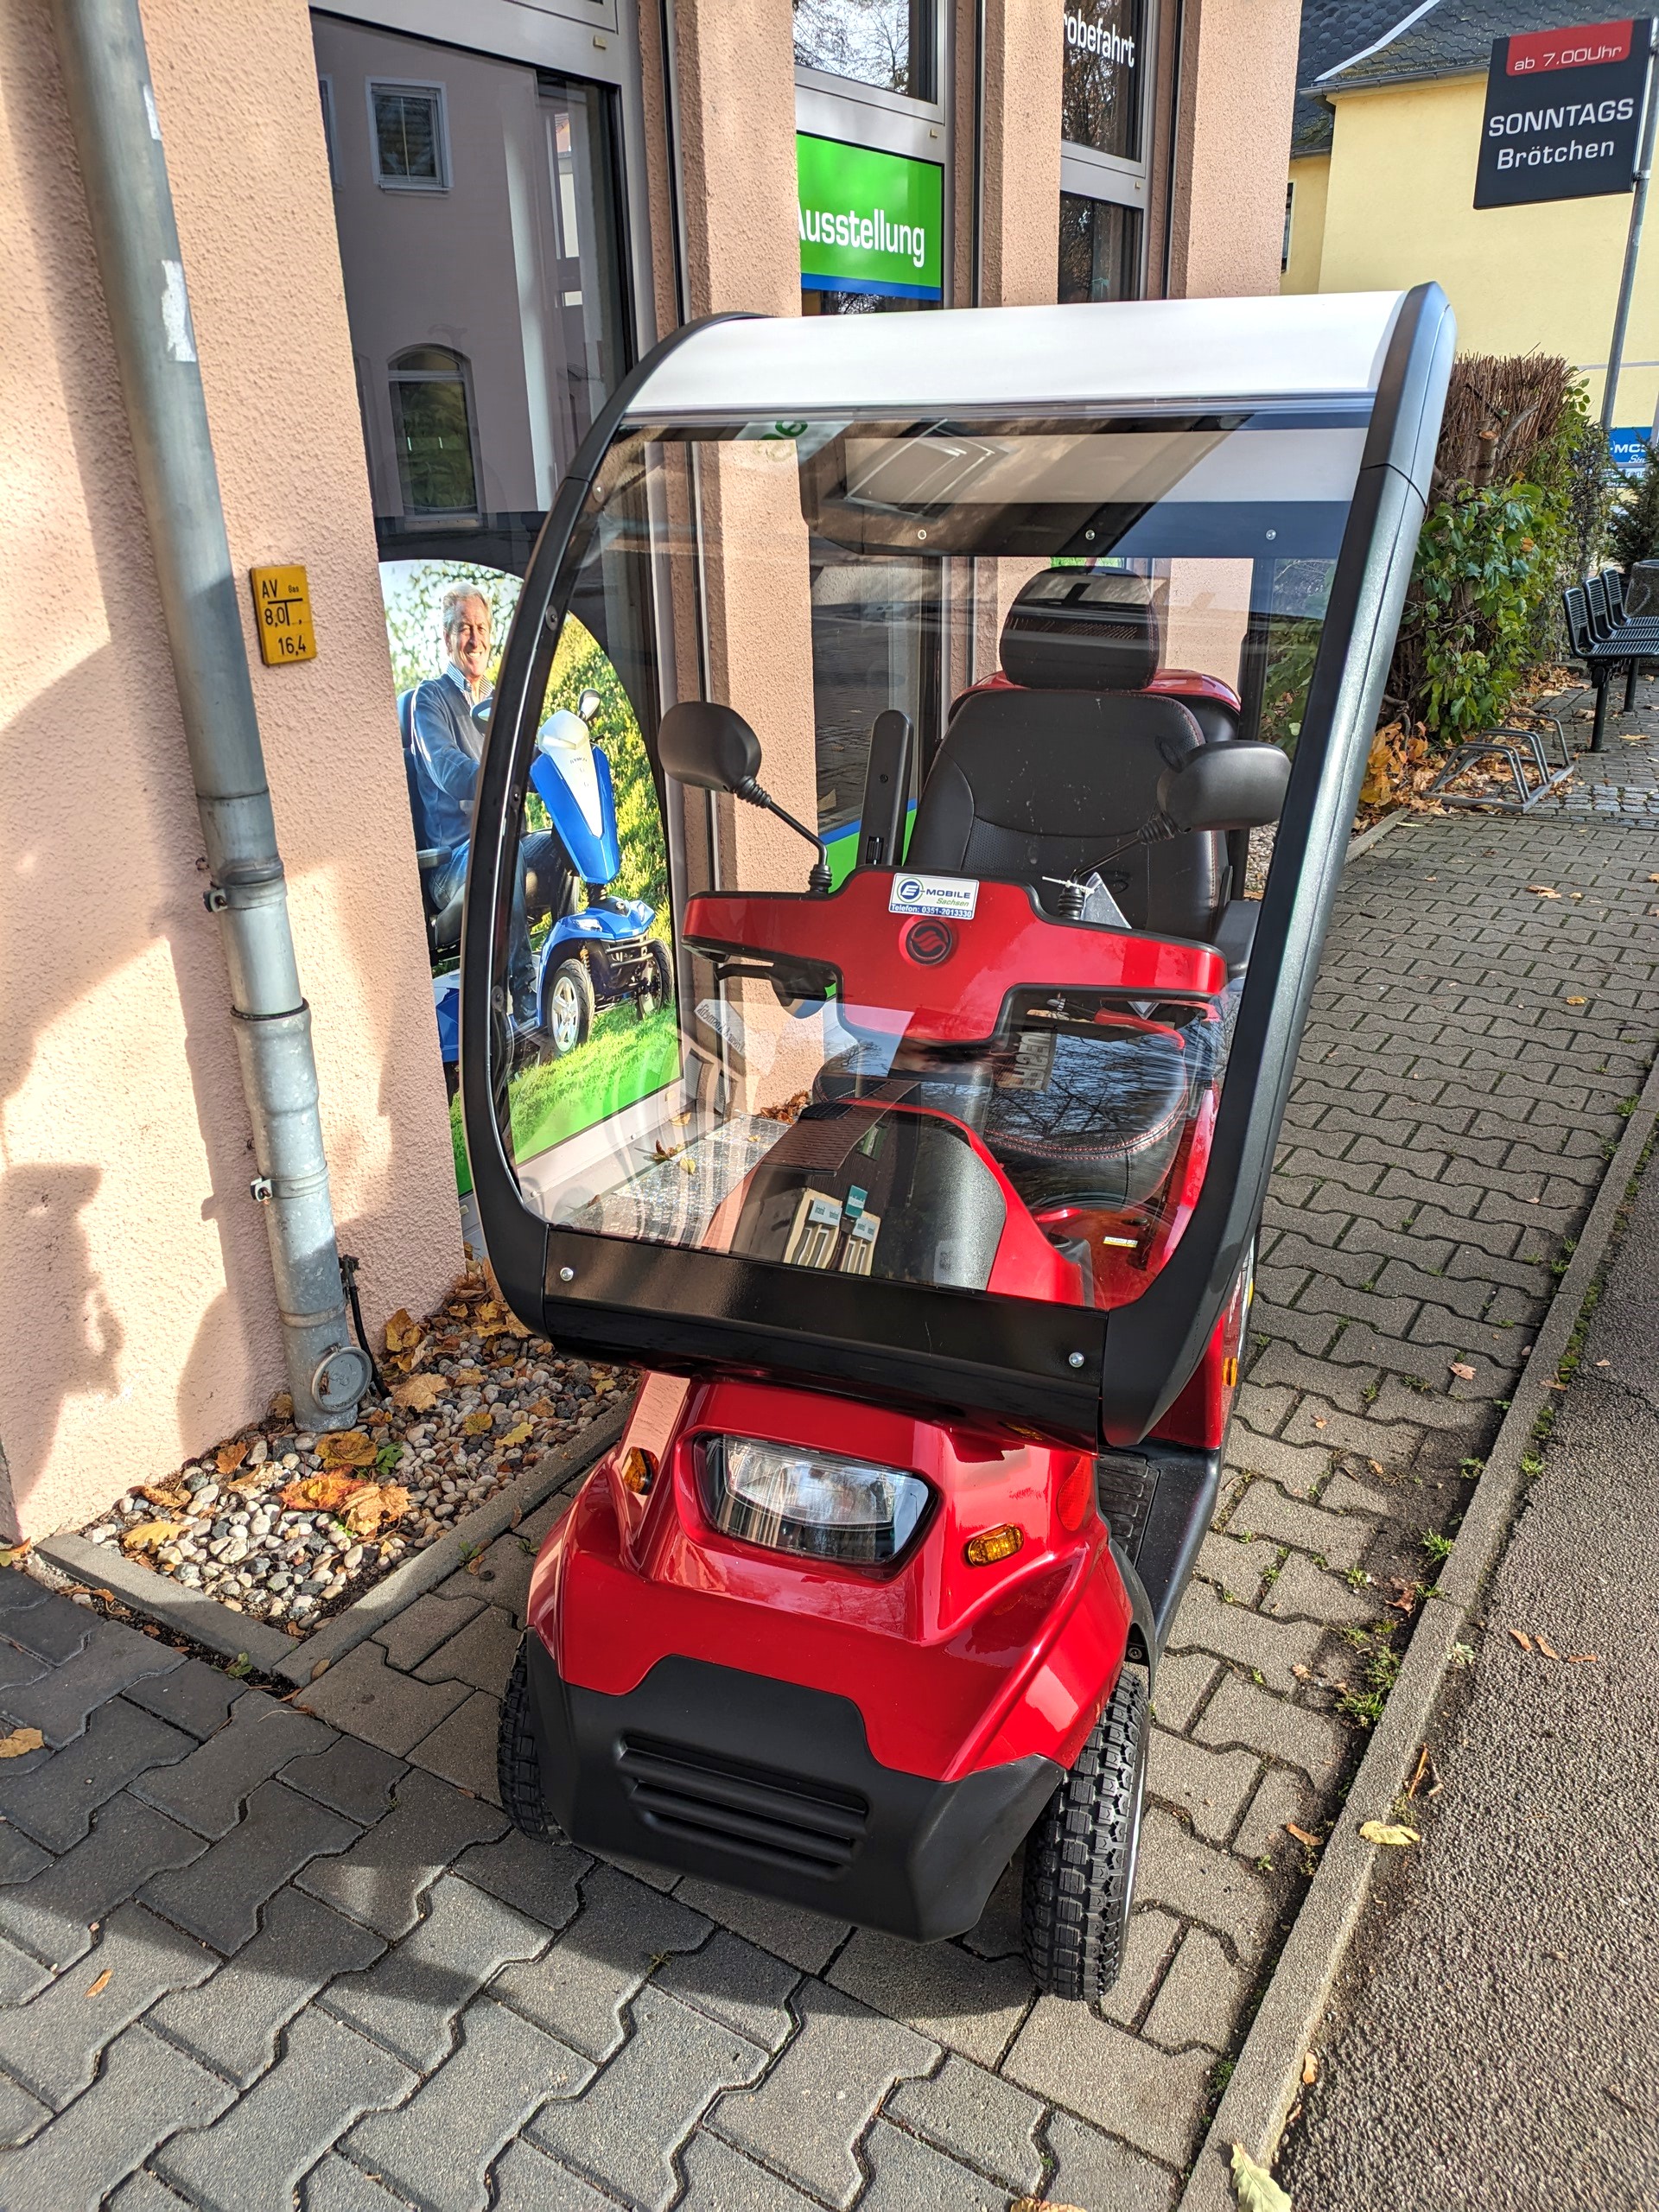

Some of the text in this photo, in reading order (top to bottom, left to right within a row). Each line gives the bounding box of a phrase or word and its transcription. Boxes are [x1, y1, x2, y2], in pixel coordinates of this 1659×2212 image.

[1514, 45, 1623, 71] ab 7.00Uhr
[1488, 98, 1635, 137] SONNTAGS
[1497, 140, 1615, 170] Brötchen
[262, 578, 277, 599] AV
[264, 607, 286, 628] 8,0
[278, 634, 307, 656] 16,4
[900, 883, 971, 899] E-MOBILE
[891, 903, 972, 918] Telefon: 0351-2013330
[936, 897, 969, 907] Sachsen
